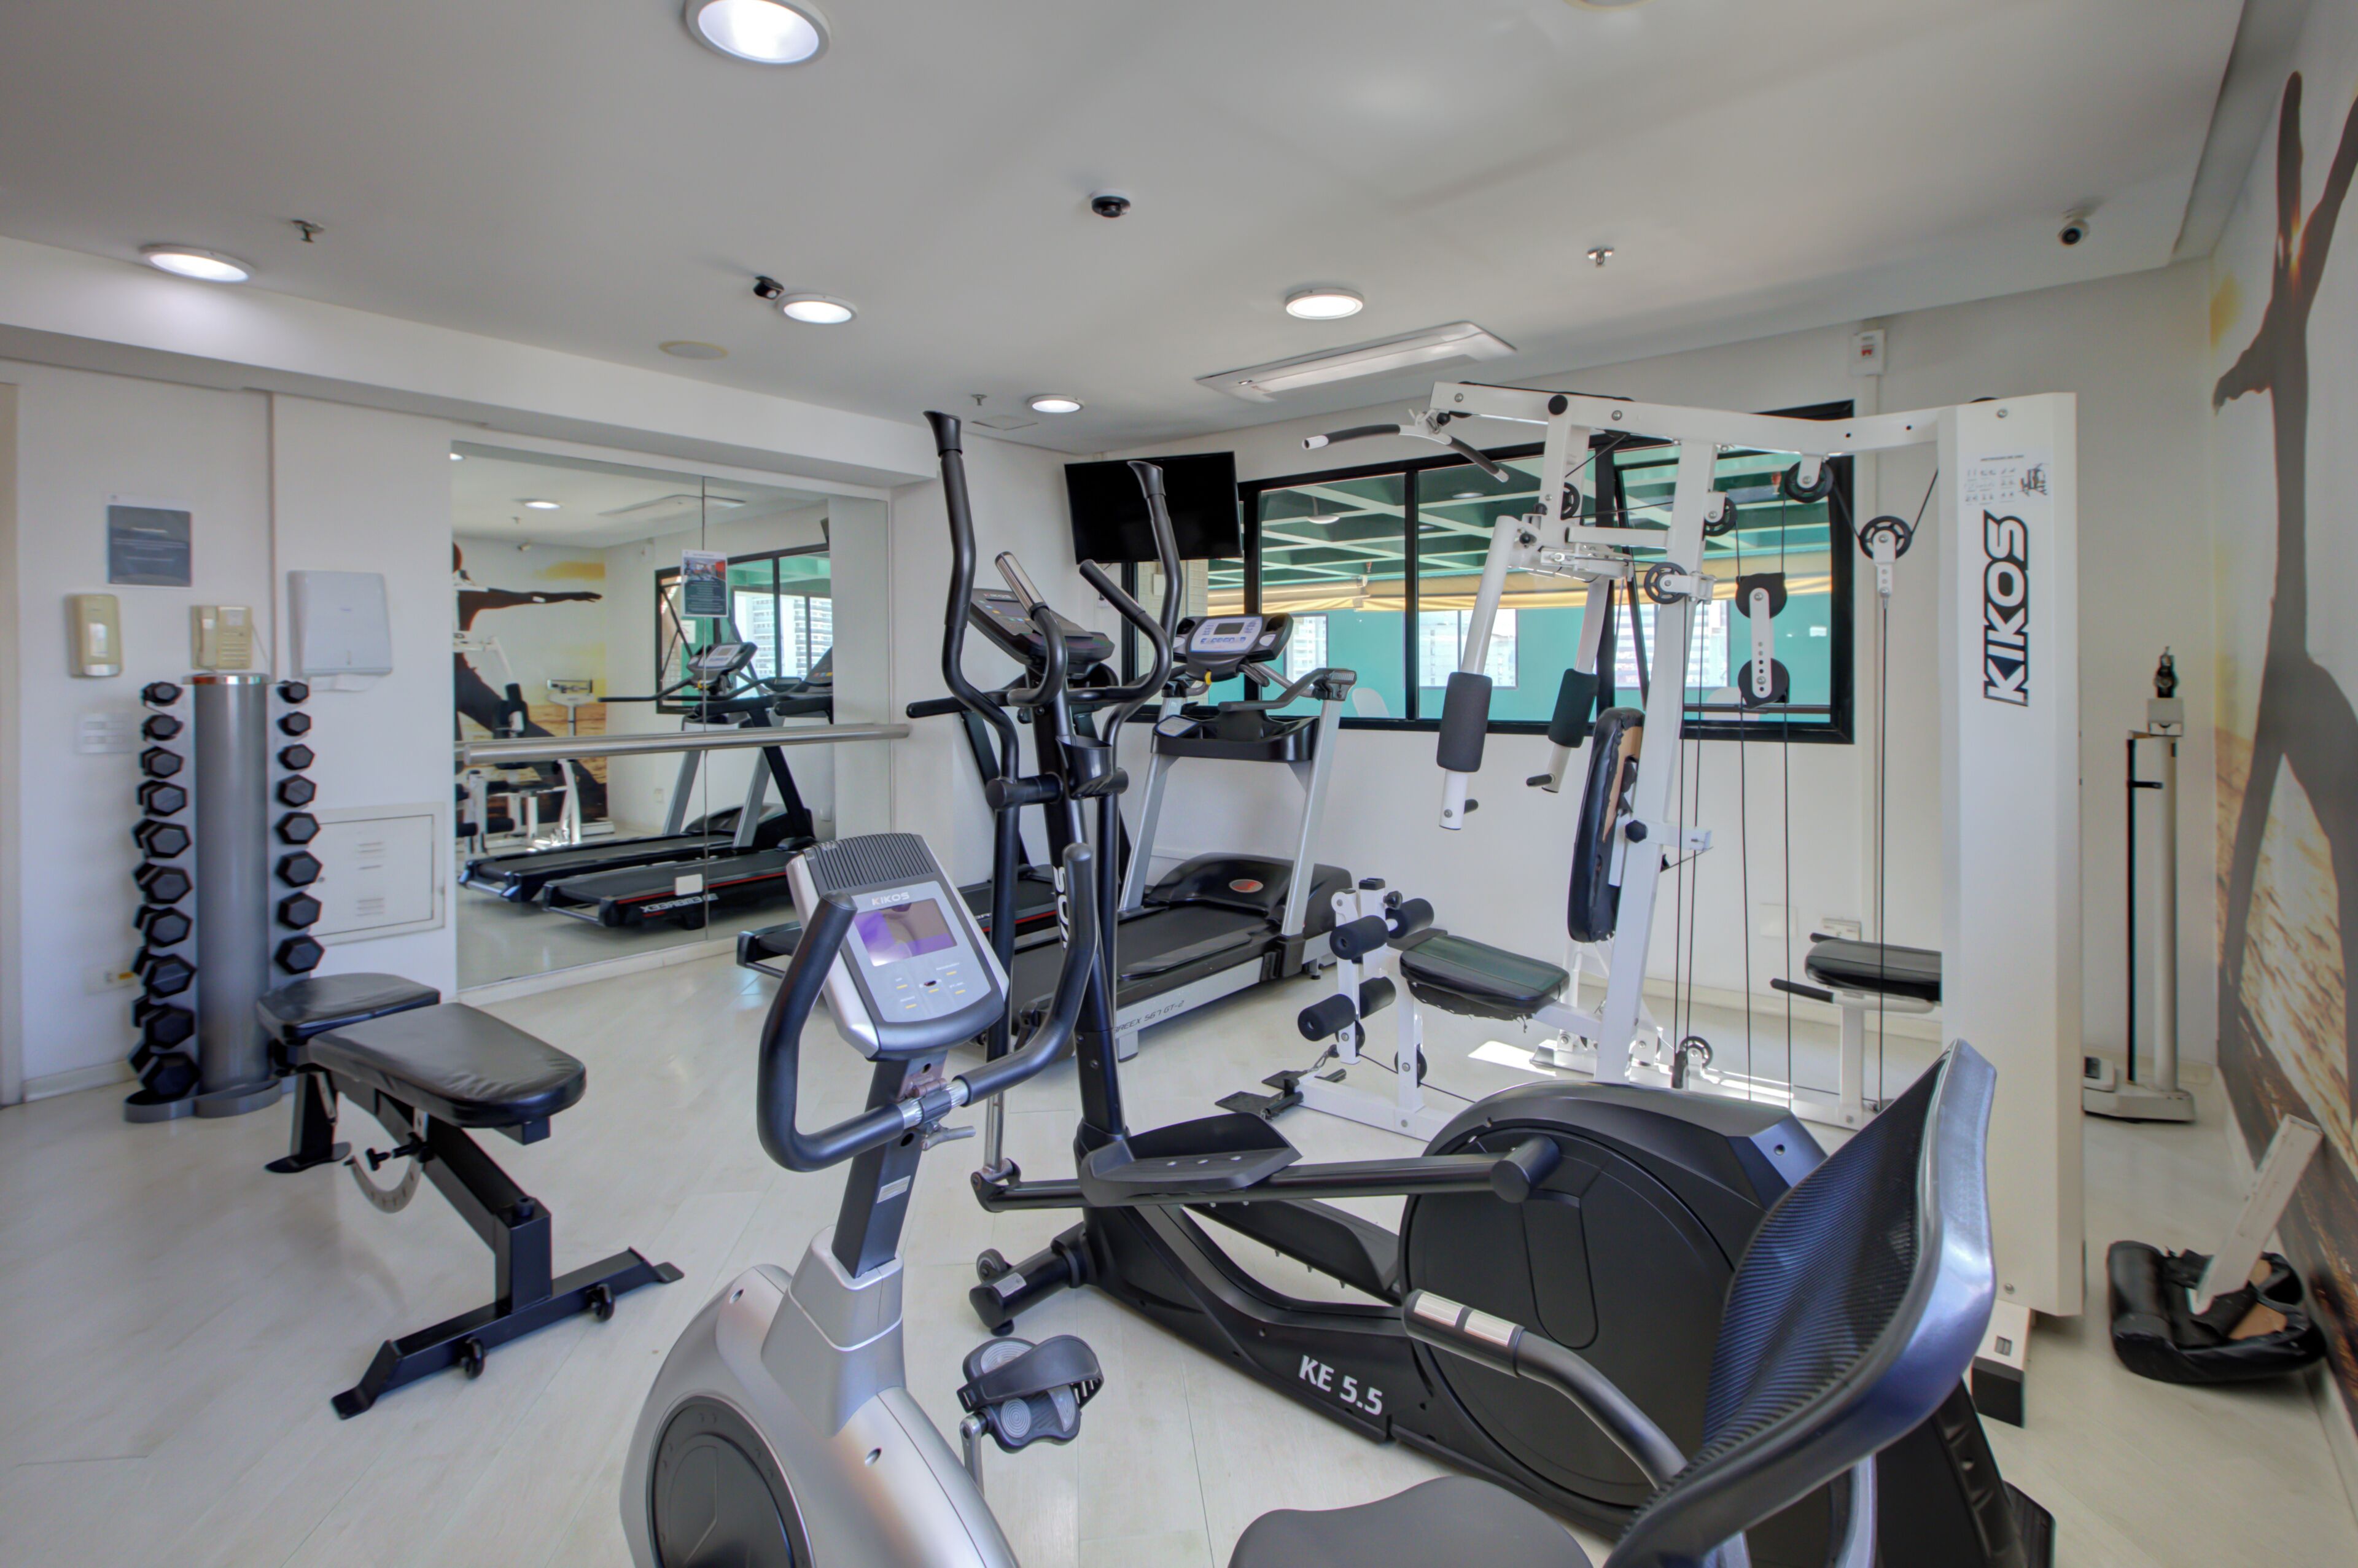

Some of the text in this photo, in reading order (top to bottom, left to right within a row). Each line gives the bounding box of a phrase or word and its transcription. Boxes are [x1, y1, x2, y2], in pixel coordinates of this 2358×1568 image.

[1983, 510, 2029, 707] KIKOS
[871, 891, 910, 906] KIKOS
[1298, 1354, 1383, 1416] KE 5.5
